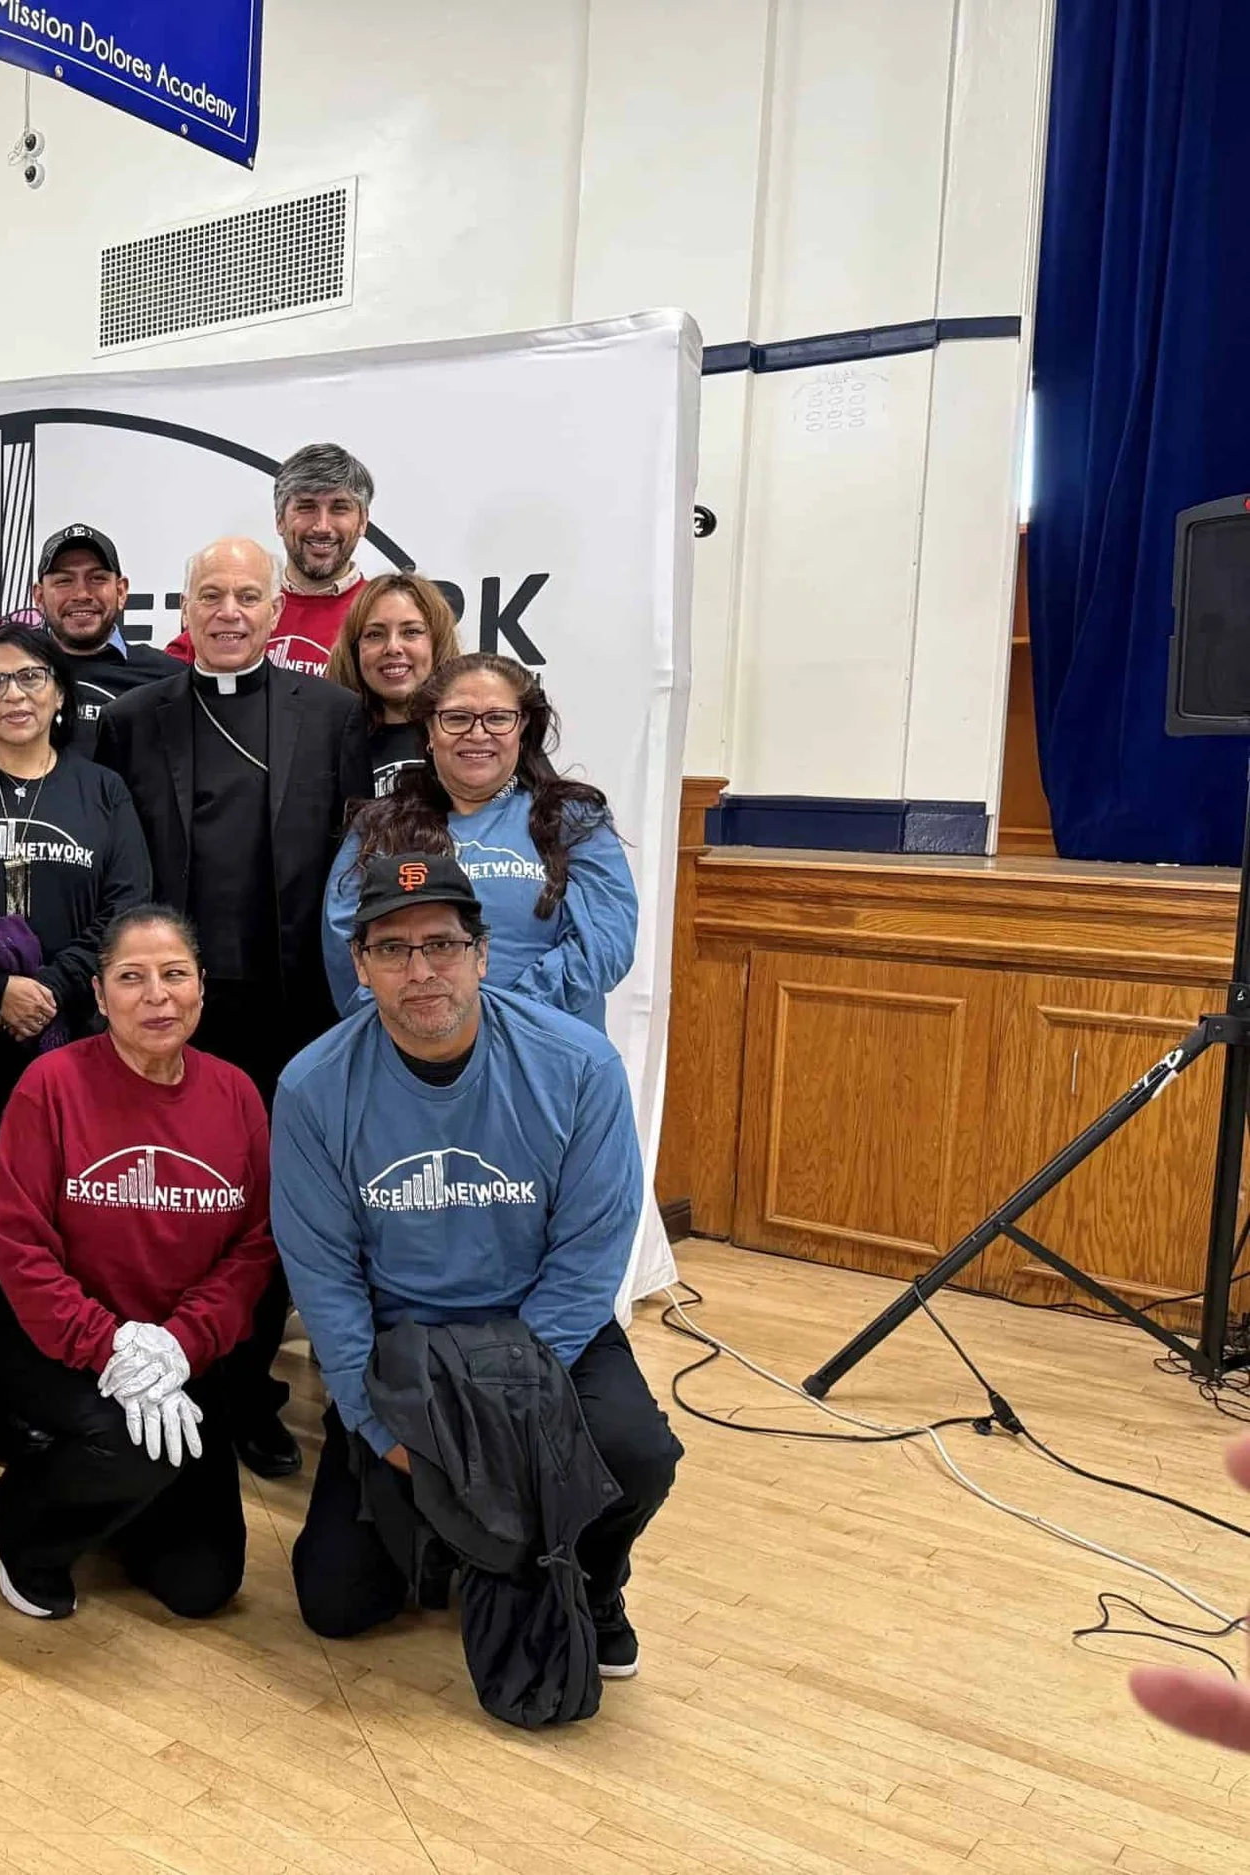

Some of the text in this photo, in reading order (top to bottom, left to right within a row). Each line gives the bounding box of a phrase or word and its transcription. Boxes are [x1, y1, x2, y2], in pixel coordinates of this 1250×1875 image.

[80, 21, 152, 83] Dolores
[156, 62, 237, 128] Academy
[286, 659, 327, 678] NETW
[15, 842, 94, 866] NETWORK
[459, 861, 546, 879] NETWORK
[155, 1185, 246, 1208] NETWORK
[444, 1180, 536, 1203] NETWORK
